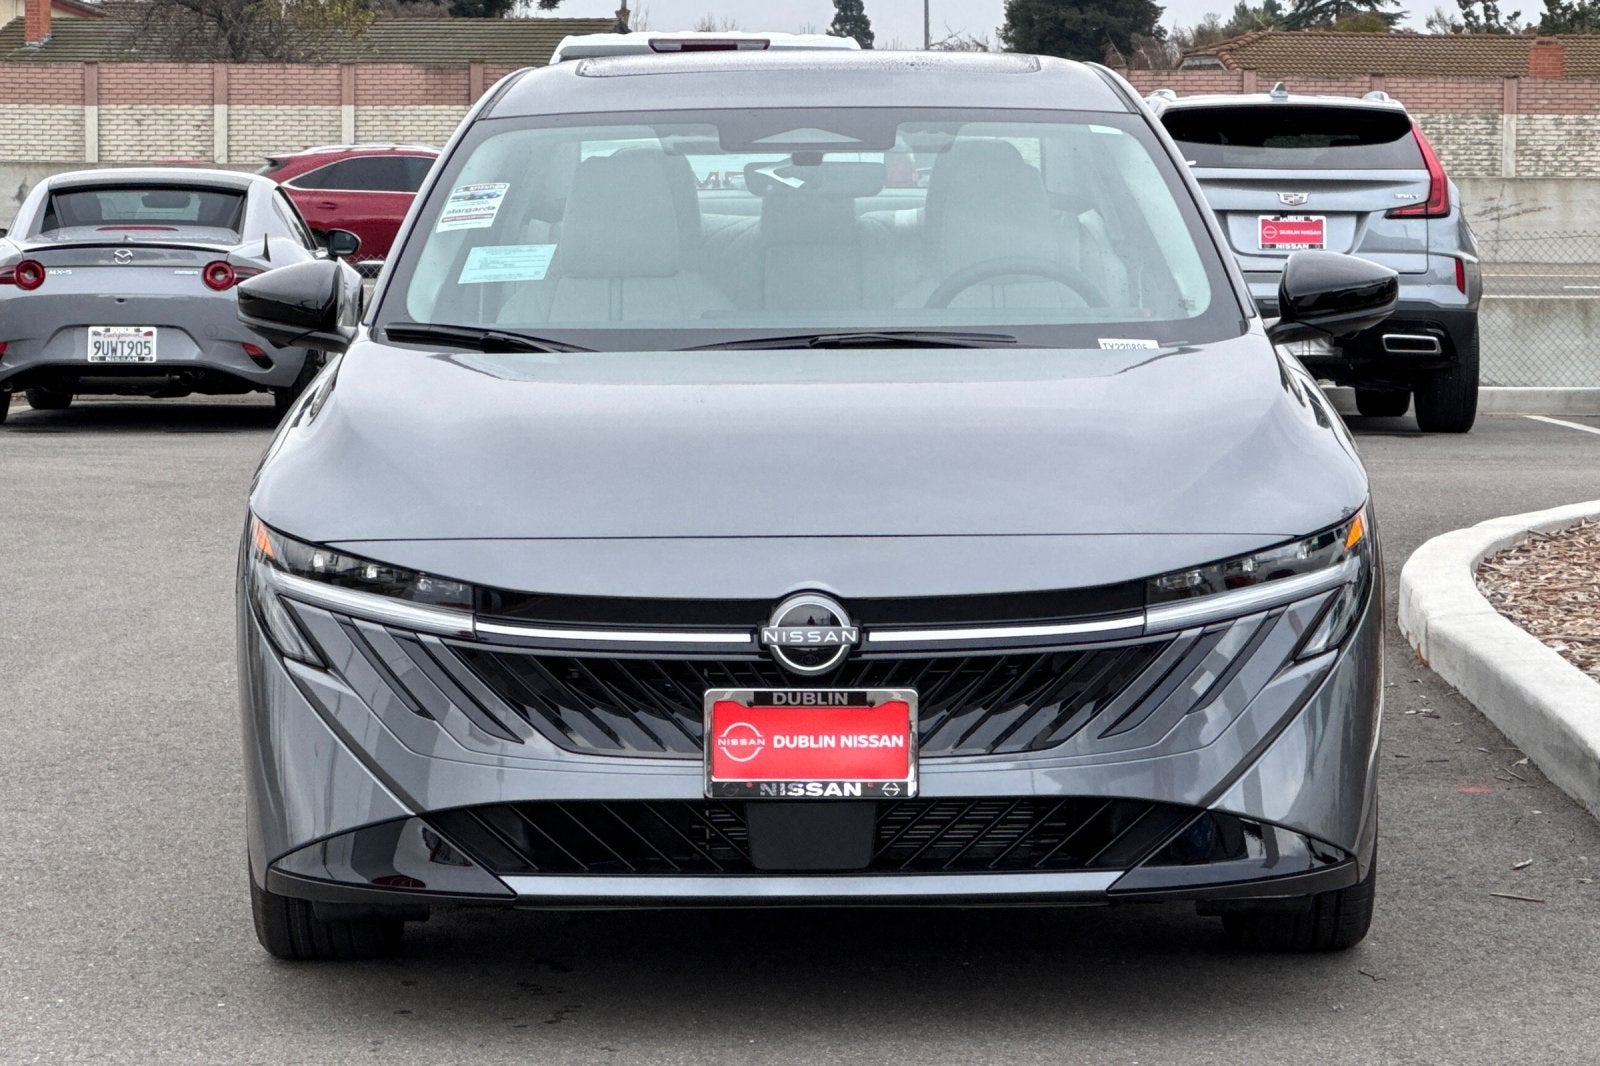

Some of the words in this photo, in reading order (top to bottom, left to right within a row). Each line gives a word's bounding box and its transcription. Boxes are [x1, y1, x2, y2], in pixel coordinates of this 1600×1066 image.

[93, 340, 152, 356] 9UWT905
[763, 630, 857, 643] NISSAN
[772, 692, 849, 706] DUBLIN
[717, 738, 766, 746] NISSAN
[773, 735, 836, 749] DUBLIN
[840, 735, 904, 748] NISSAN
[759, 782, 862, 797] NISSAN
